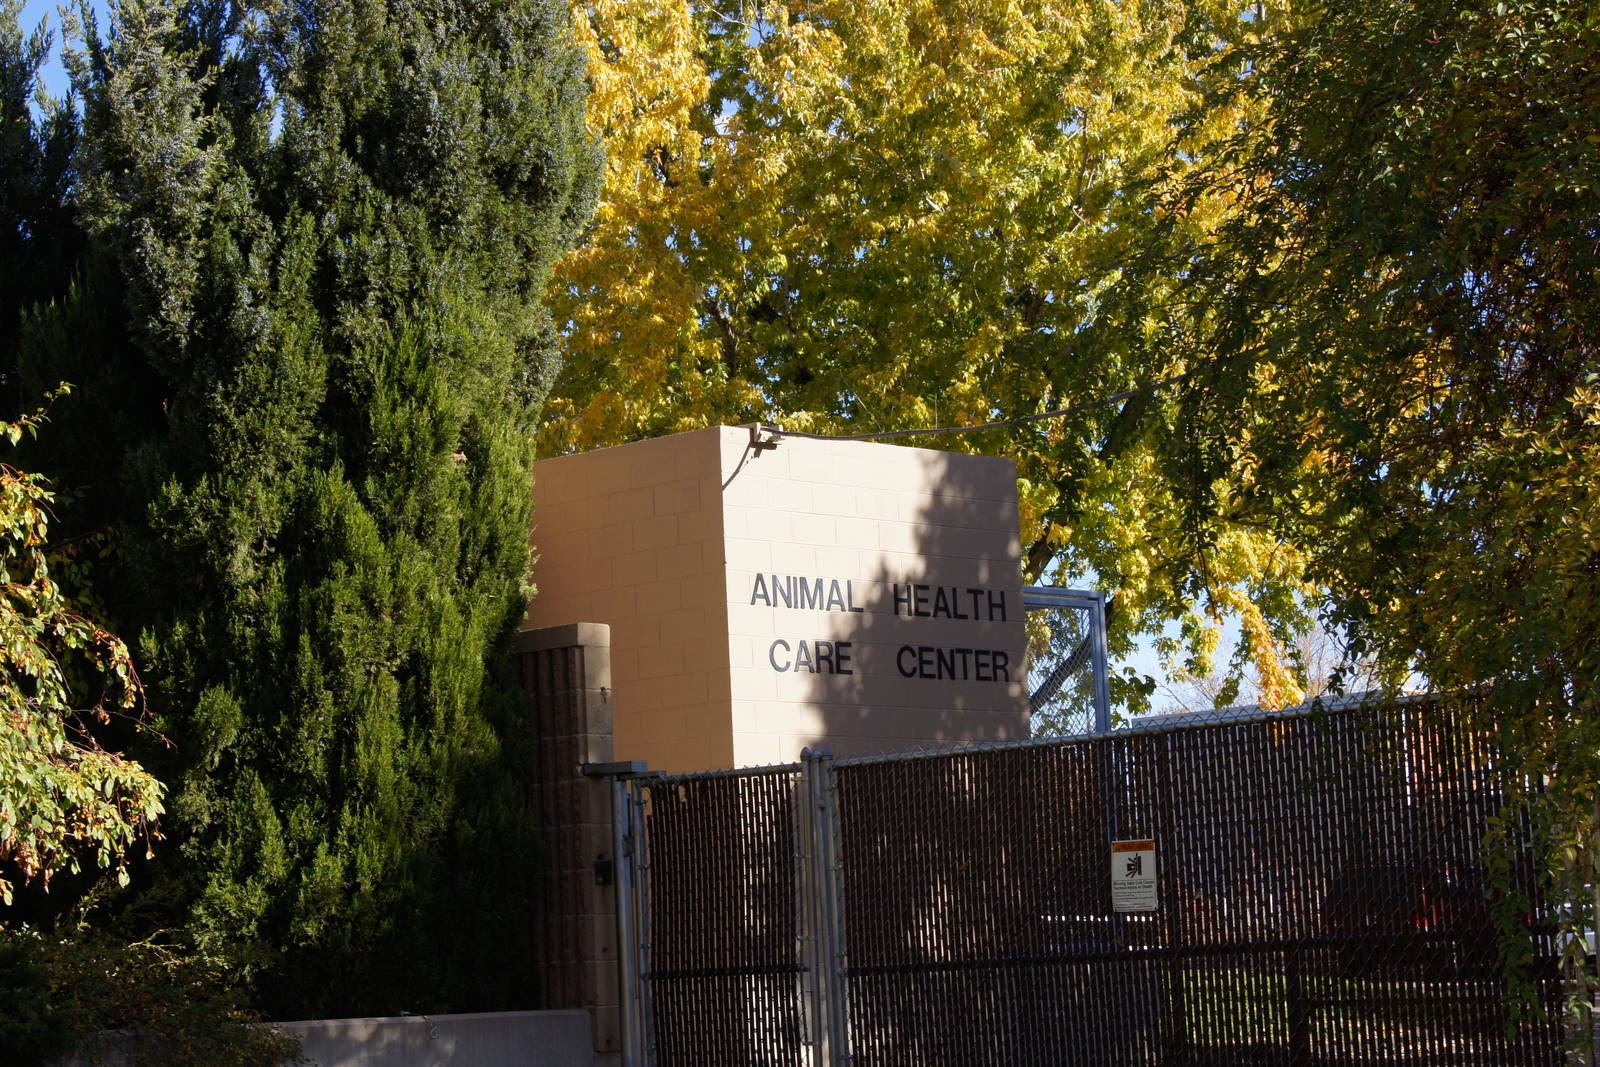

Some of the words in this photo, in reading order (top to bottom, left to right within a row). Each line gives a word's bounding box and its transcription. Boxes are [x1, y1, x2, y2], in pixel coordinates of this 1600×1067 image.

[750, 572, 864, 613] ANIMAL
[893, 583, 1007, 622] HEALTH
[768, 638, 854, 675] CARE
[896, 645, 1010, 683] CENTER
